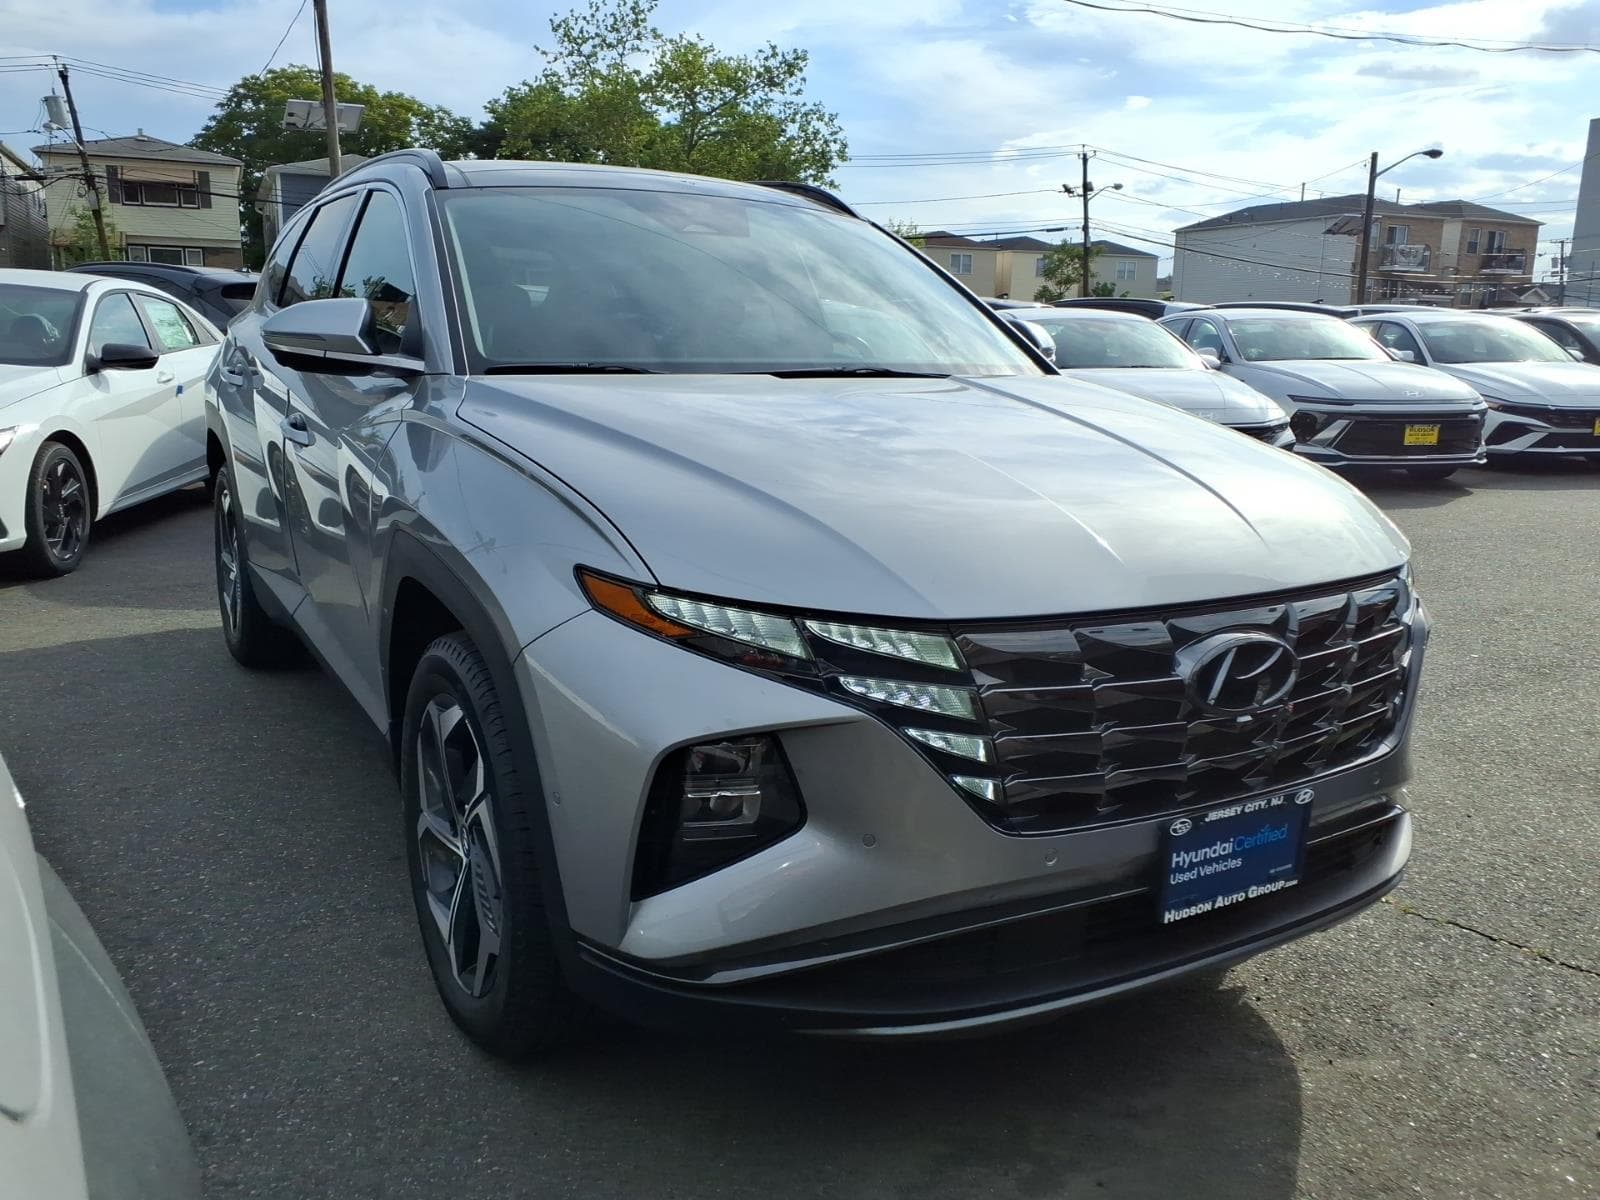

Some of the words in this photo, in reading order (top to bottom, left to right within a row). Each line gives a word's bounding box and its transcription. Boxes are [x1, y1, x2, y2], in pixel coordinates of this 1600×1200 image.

[1205, 806, 1243, 822] JERSEY
[1271, 796, 1284, 807] NJ
[1170, 868, 1198, 885] Used
[1199, 857, 1242, 877] Vehicles
[1164, 901, 1213, 924] HUDSON
[1215, 892, 1246, 909] AUTO
